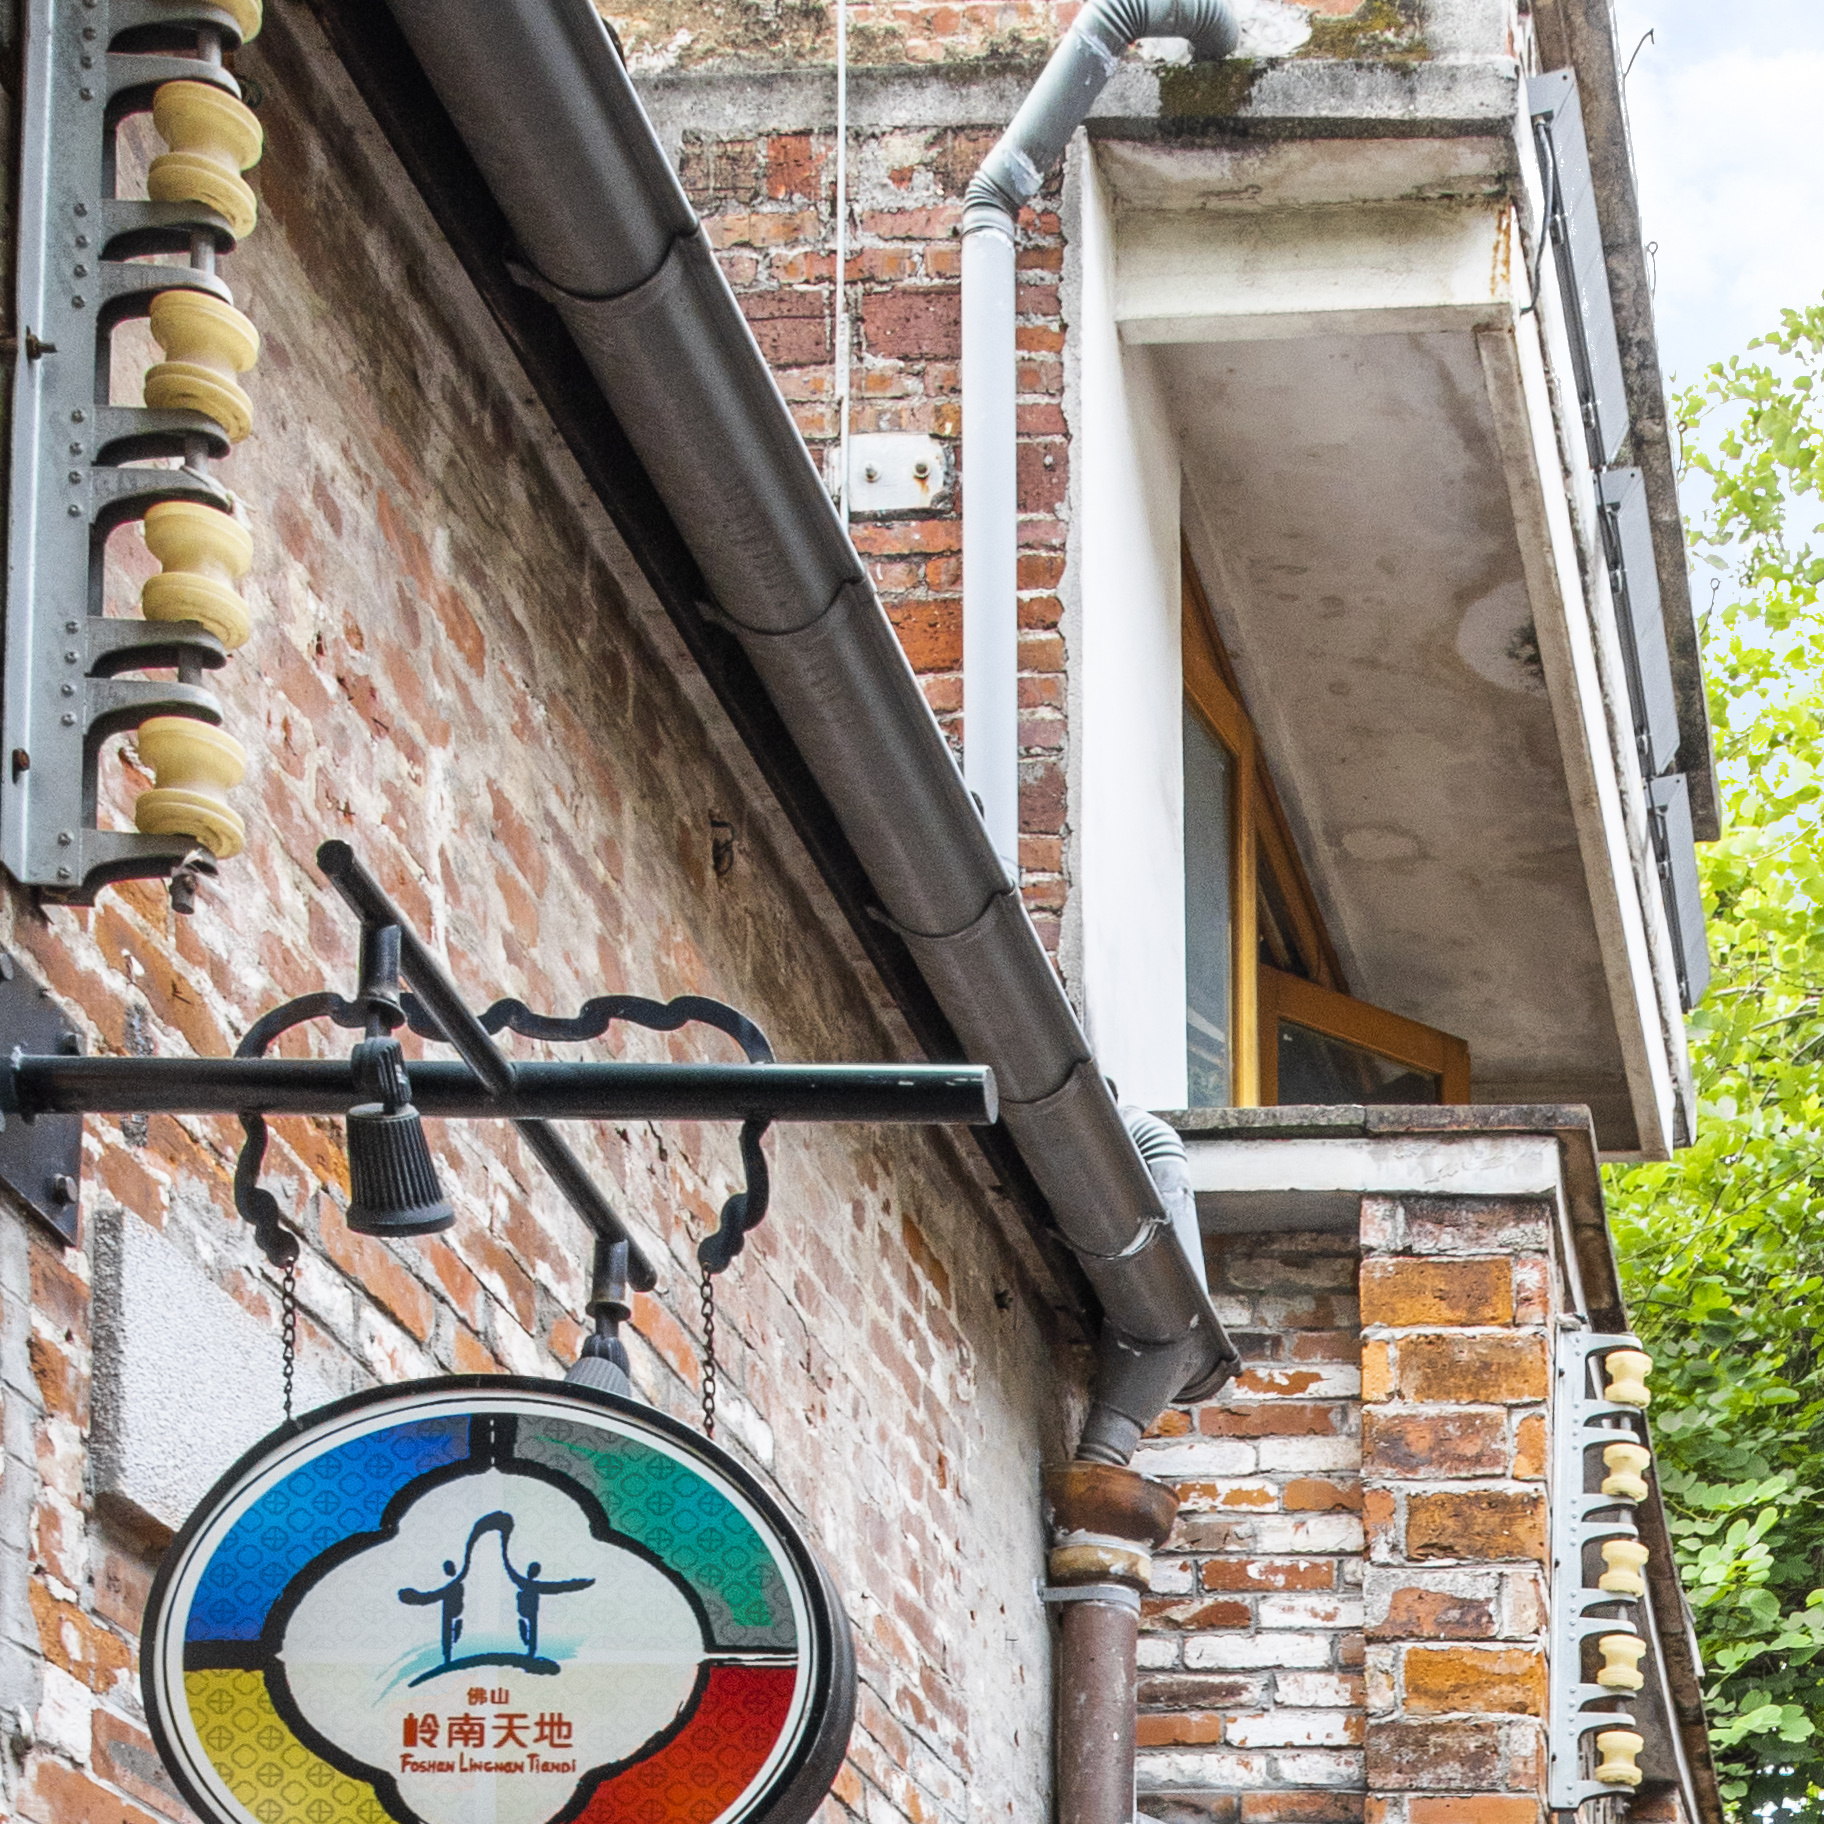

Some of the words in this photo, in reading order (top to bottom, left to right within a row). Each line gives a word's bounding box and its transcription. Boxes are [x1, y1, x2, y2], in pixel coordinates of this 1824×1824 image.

[466, 1686, 509, 1706] 佛山
[402, 1712, 573, 1749] 岭南天地
